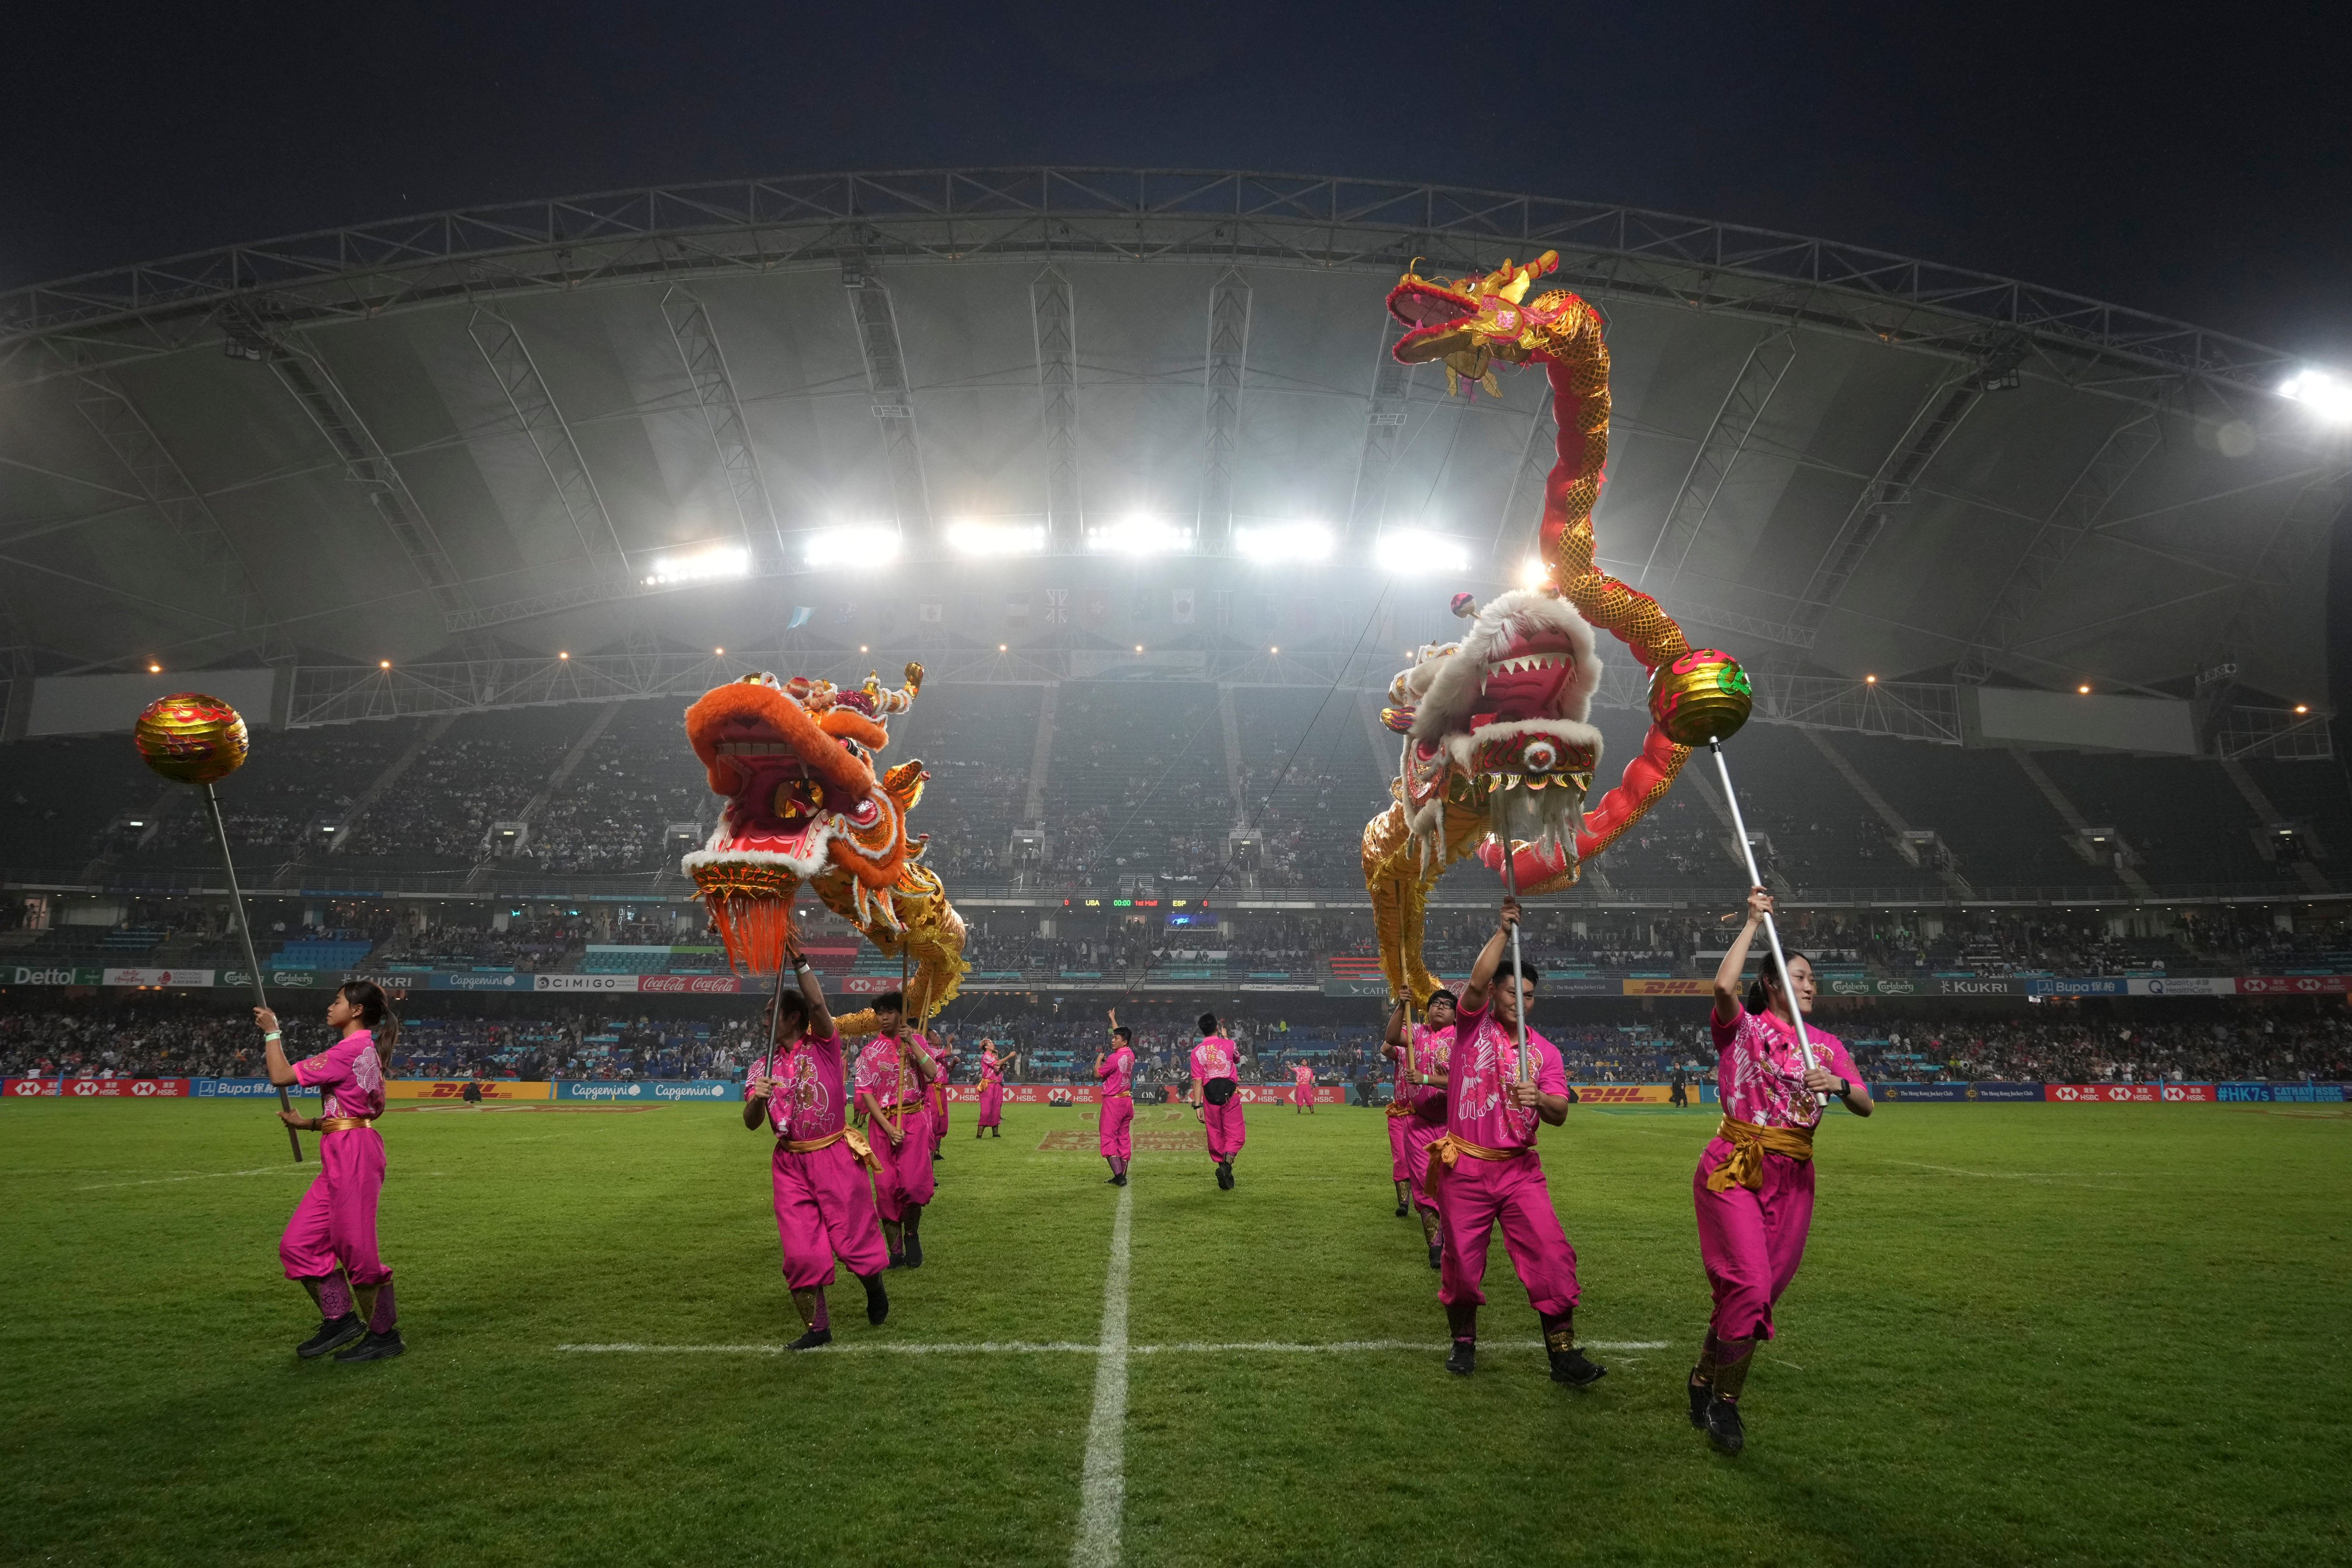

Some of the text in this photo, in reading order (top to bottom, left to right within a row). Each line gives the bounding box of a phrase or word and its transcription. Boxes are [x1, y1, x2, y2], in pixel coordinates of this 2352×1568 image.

[14, 967, 77, 984] Dettol
[274, 972, 313, 984] Carlsberg
[450, 975, 503, 989] Capgemini
[553, 979, 615, 988] CIMIGO
[1644, 982, 1701, 994] DHL
[1832, 981, 1869, 992] Carlsberg
[1877, 981, 1914, 992] Carlsberg
[1955, 982, 2008, 992] KUKRI
[2056, 982, 2088, 993] Bupa
[218, 1083, 252, 1095] Bupa
[572, 1084, 627, 1100] Capgemini
[655, 1084, 711, 1100] Capgemini
[1578, 1088, 1644, 1102] DHL
[2218, 1087, 2270, 1102] #HK7s
